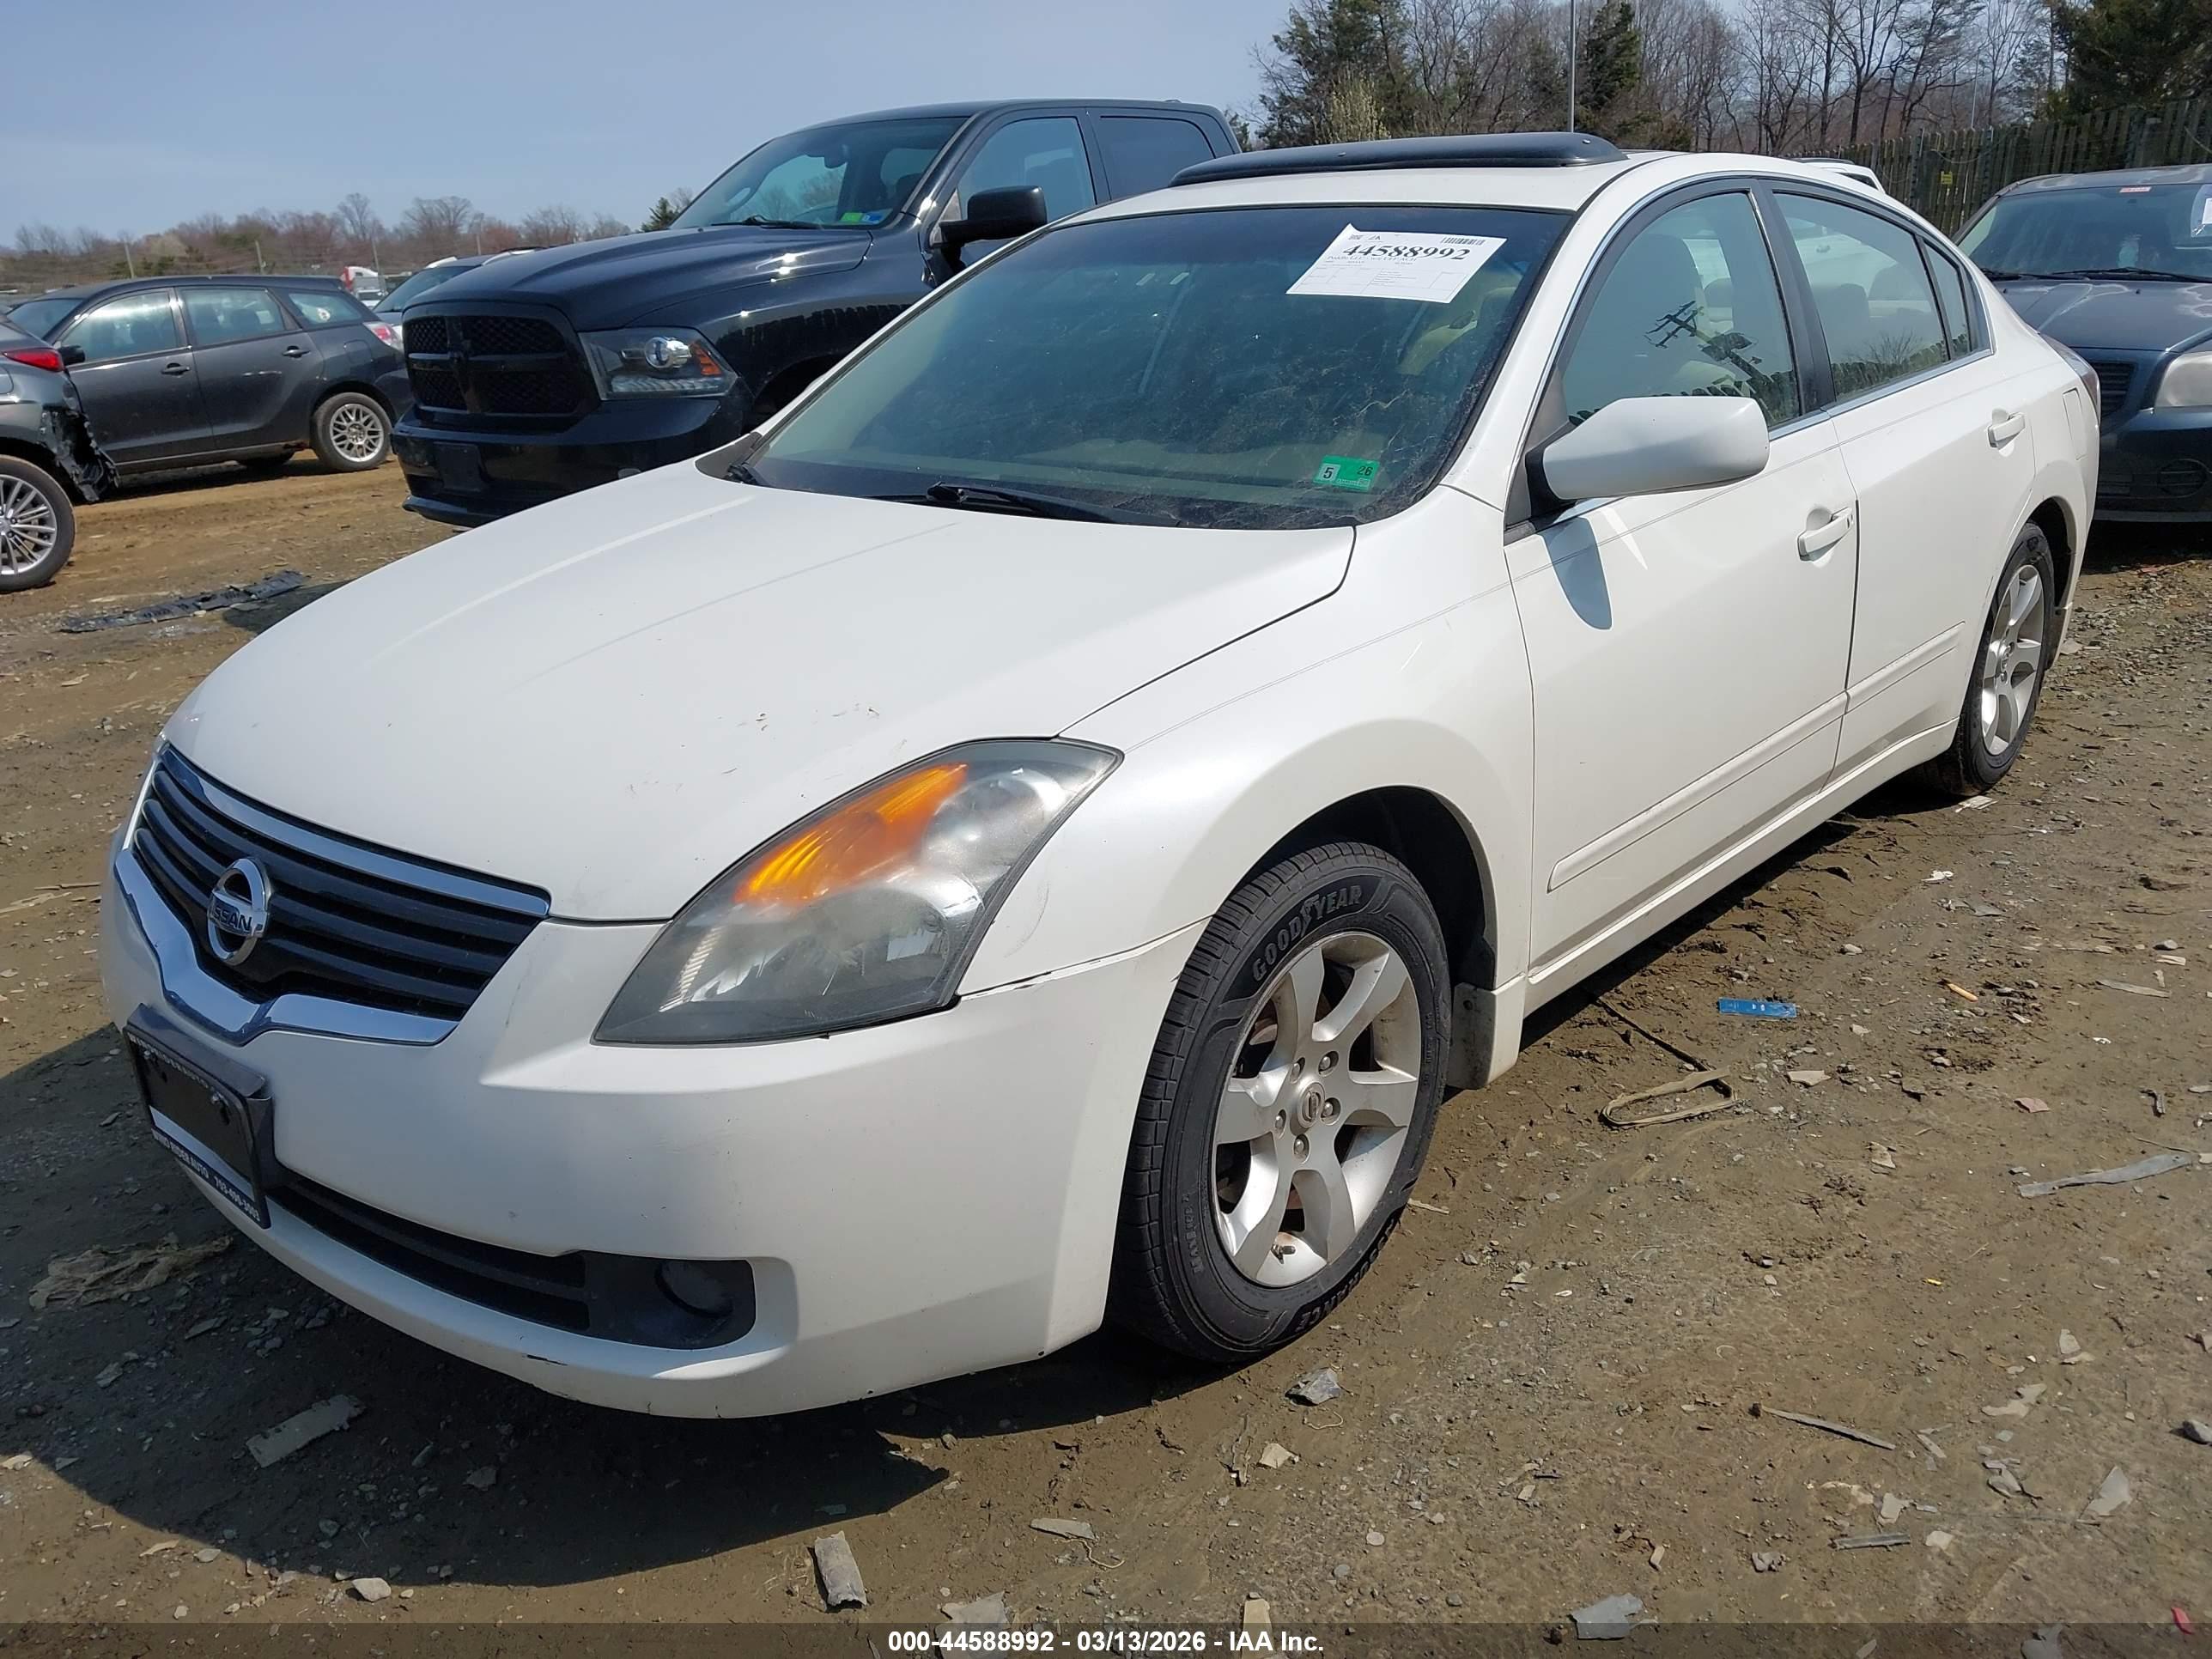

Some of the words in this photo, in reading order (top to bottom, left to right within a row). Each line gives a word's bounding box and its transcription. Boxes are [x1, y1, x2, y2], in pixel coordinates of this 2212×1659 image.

[1343, 244, 1470, 260] 44588992
[1323, 467, 1334, 479] 5
[1358, 466, 1374, 477] 26
[1252, 884, 1363, 981] GOODYEAR
